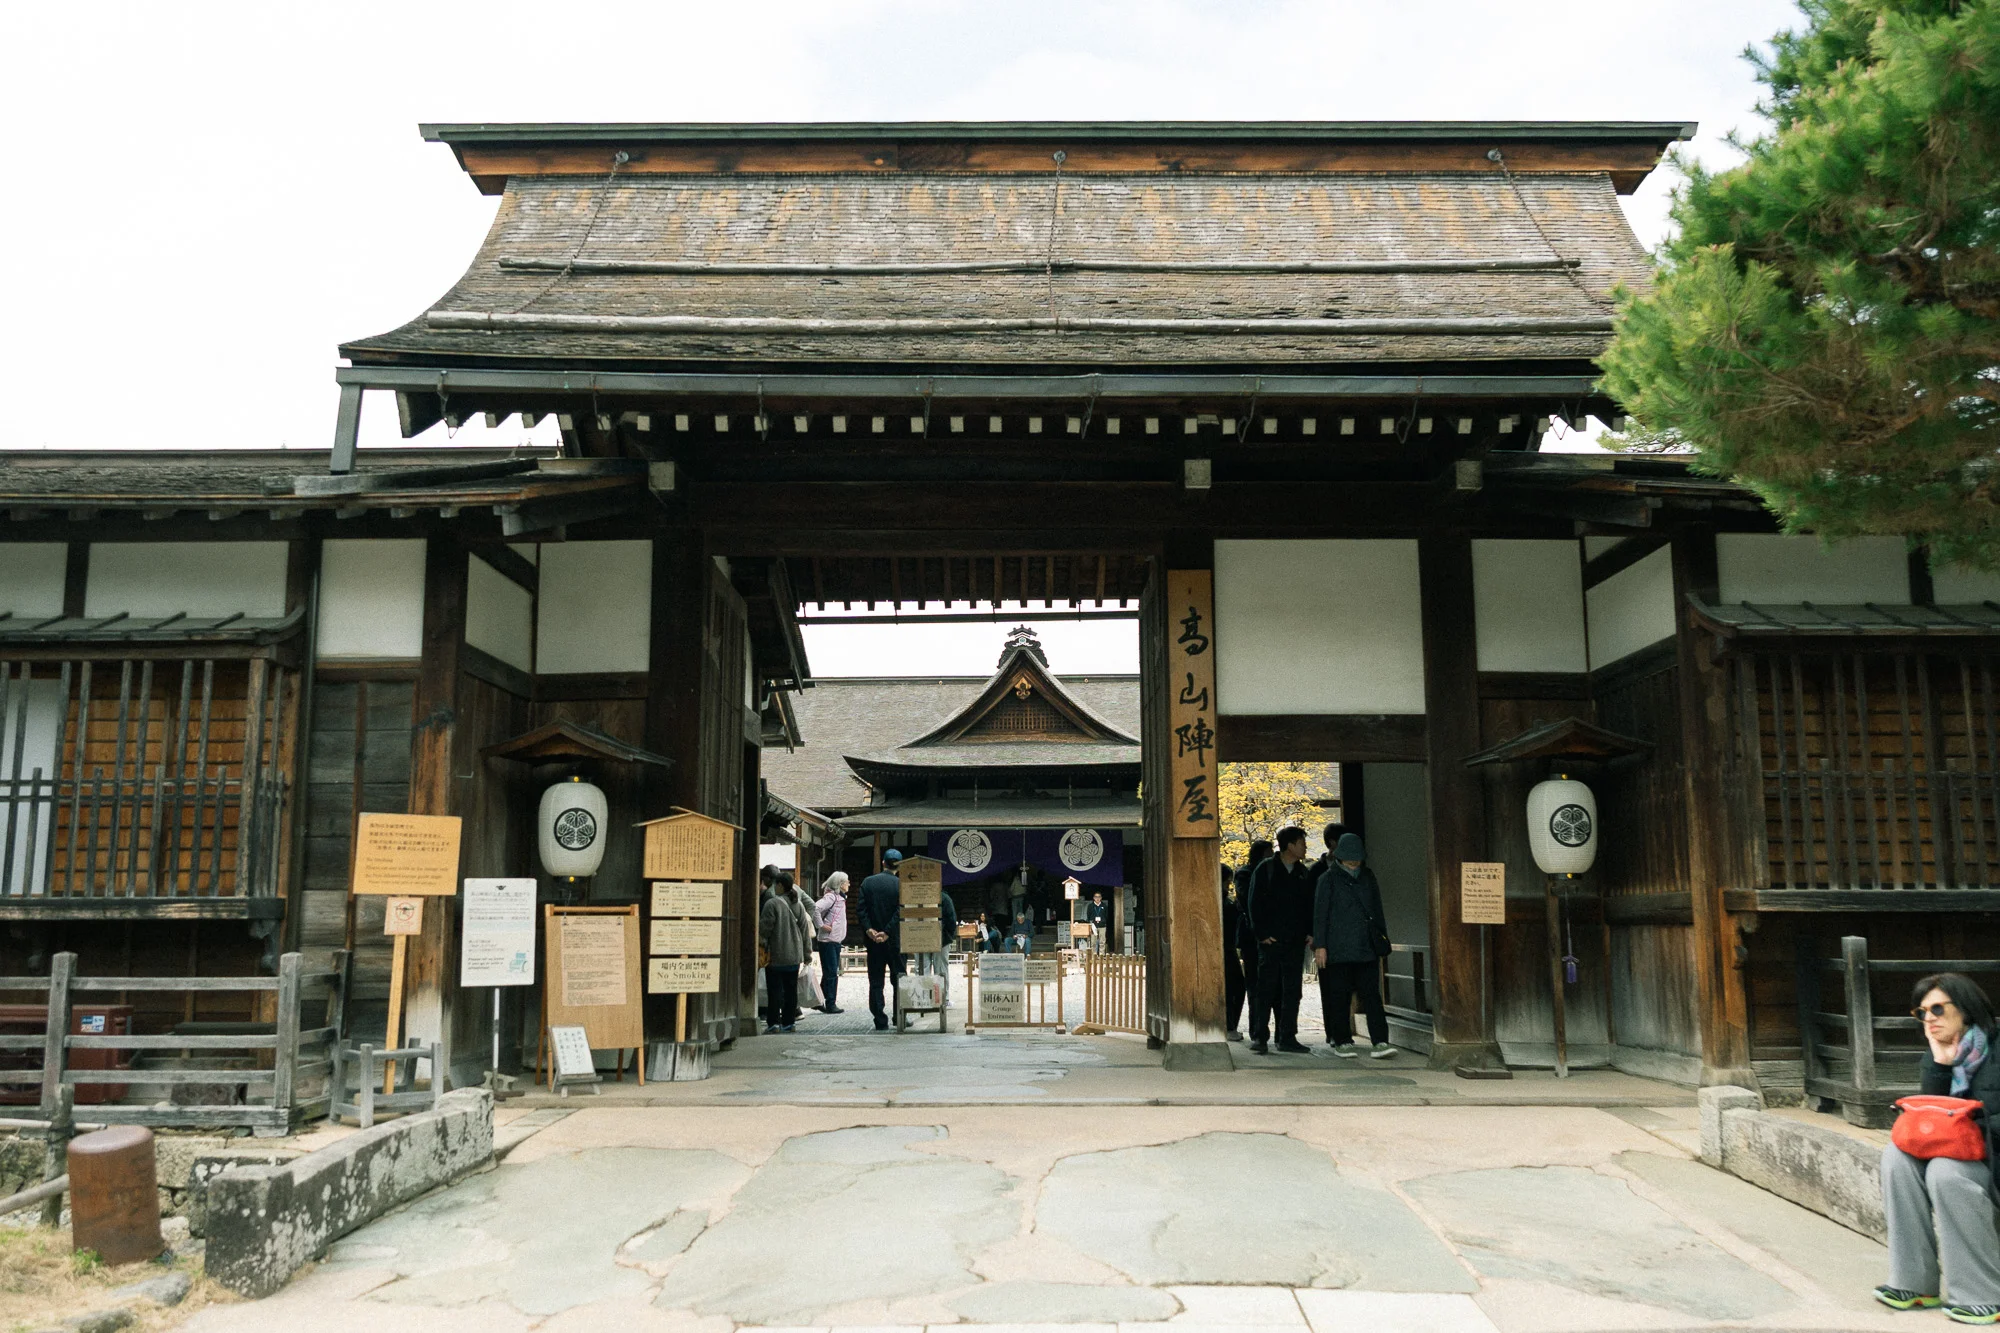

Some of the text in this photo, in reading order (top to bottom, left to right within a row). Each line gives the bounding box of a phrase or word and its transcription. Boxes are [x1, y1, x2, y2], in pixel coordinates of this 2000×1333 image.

[1174, 606, 1214, 823] 高山陣屋
[661, 962, 708, 970] 場内全面禁煙
[673, 971, 711, 980] Smoking
[983, 993, 1019, 1003] 団体入口
